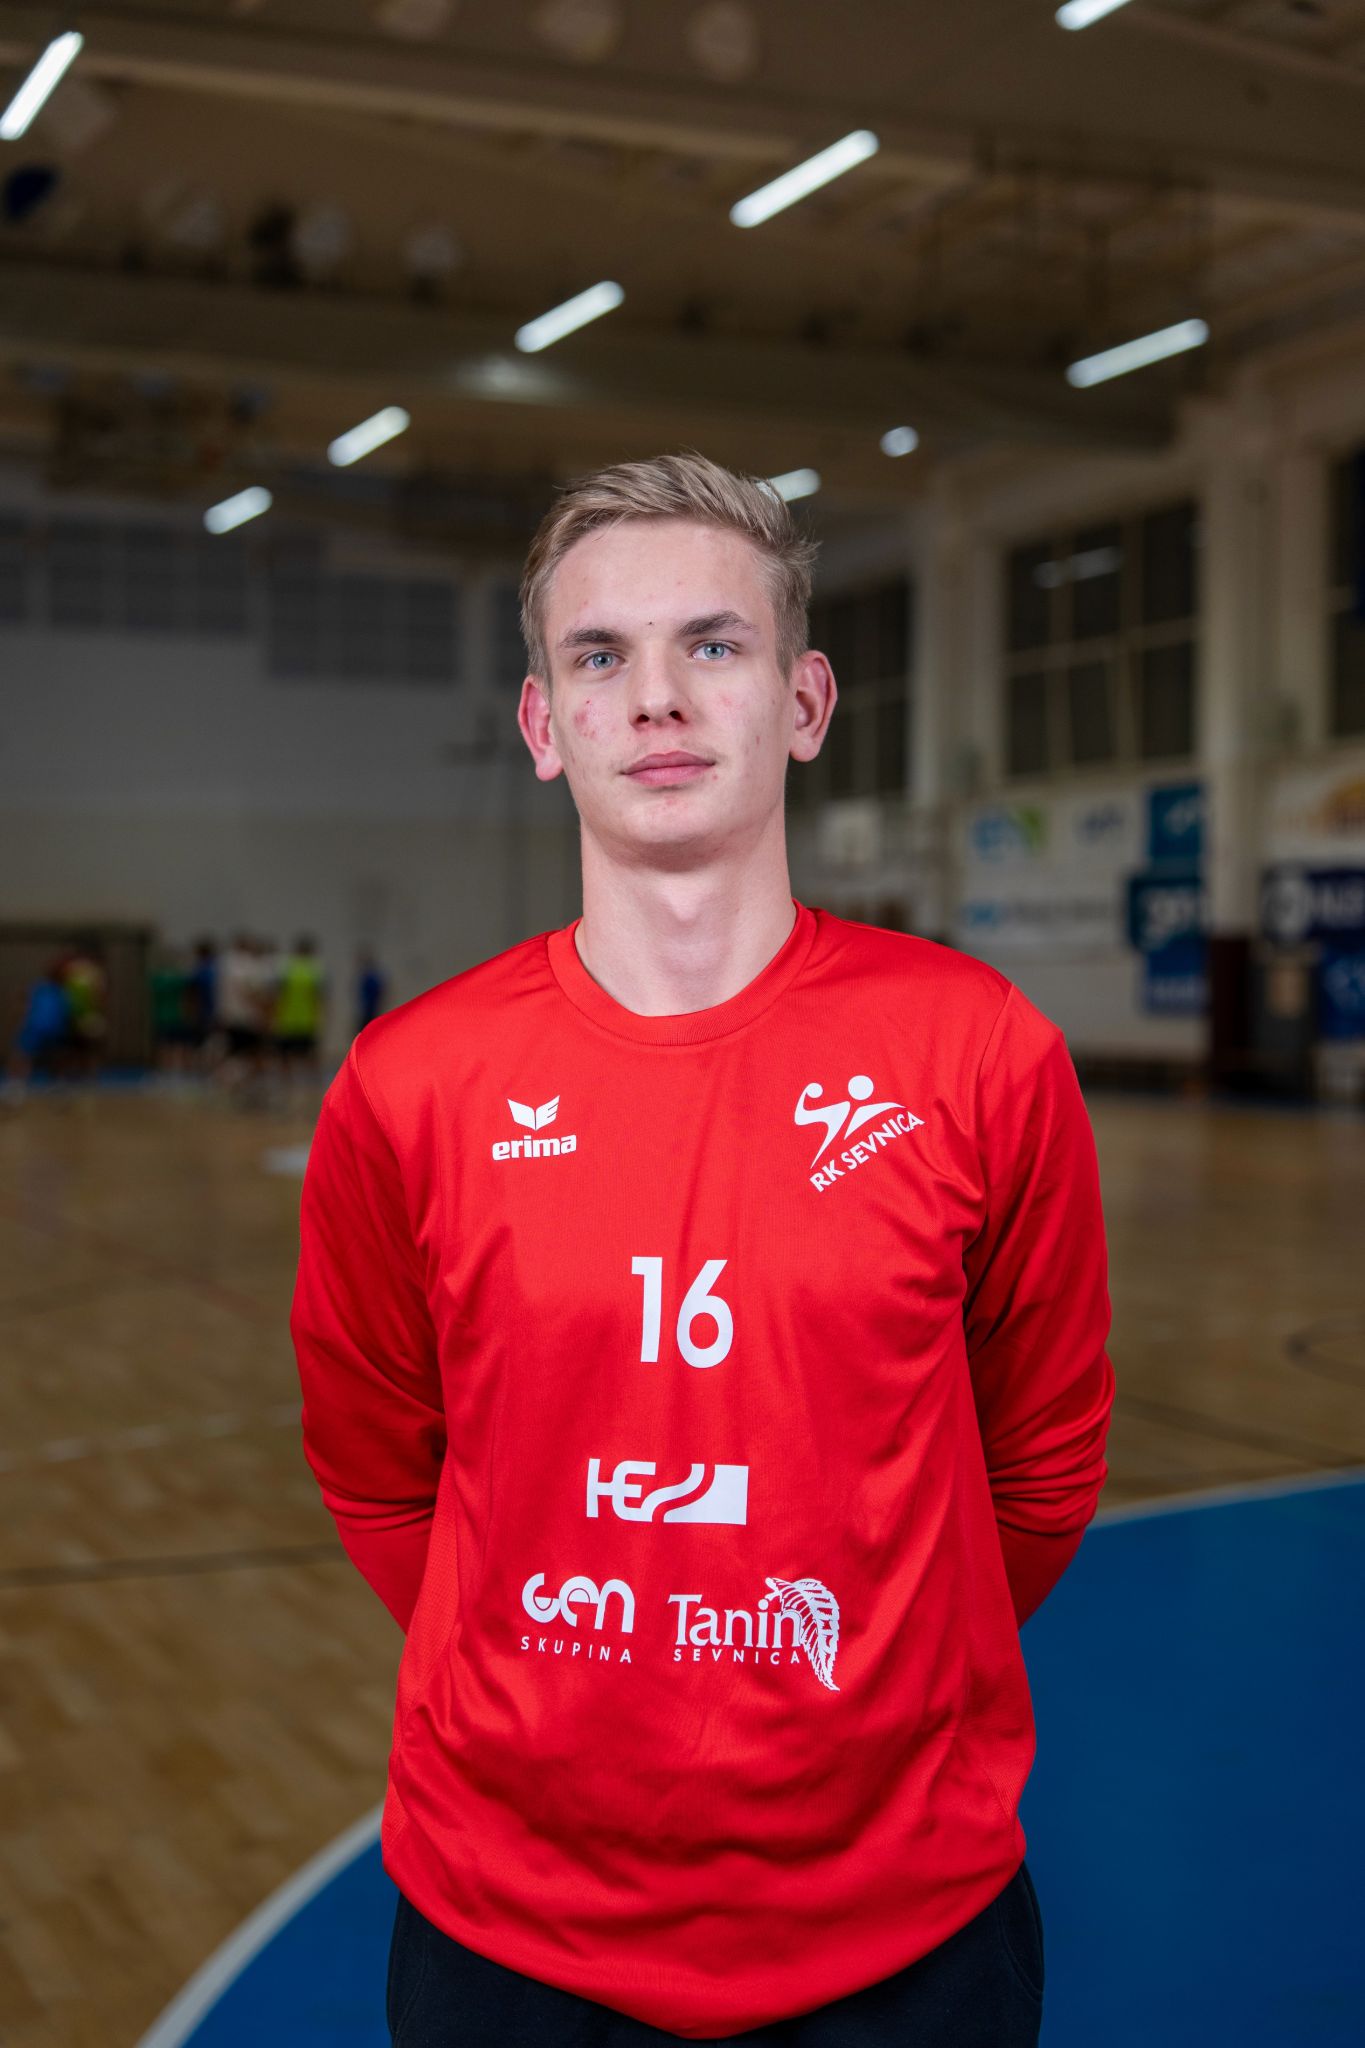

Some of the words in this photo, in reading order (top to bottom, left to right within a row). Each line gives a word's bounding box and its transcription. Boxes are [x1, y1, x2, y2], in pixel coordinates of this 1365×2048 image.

[491, 1134, 577, 1162] erima
[809, 1160, 846, 1193] RK
[841, 1111, 926, 1170] SEVNICA
[631, 1256, 734, 1369] 16
[667, 1594, 802, 1649] Tanin
[520, 1636, 632, 1664] SKUPINA
[673, 1648, 800, 1666] SEVNICA
